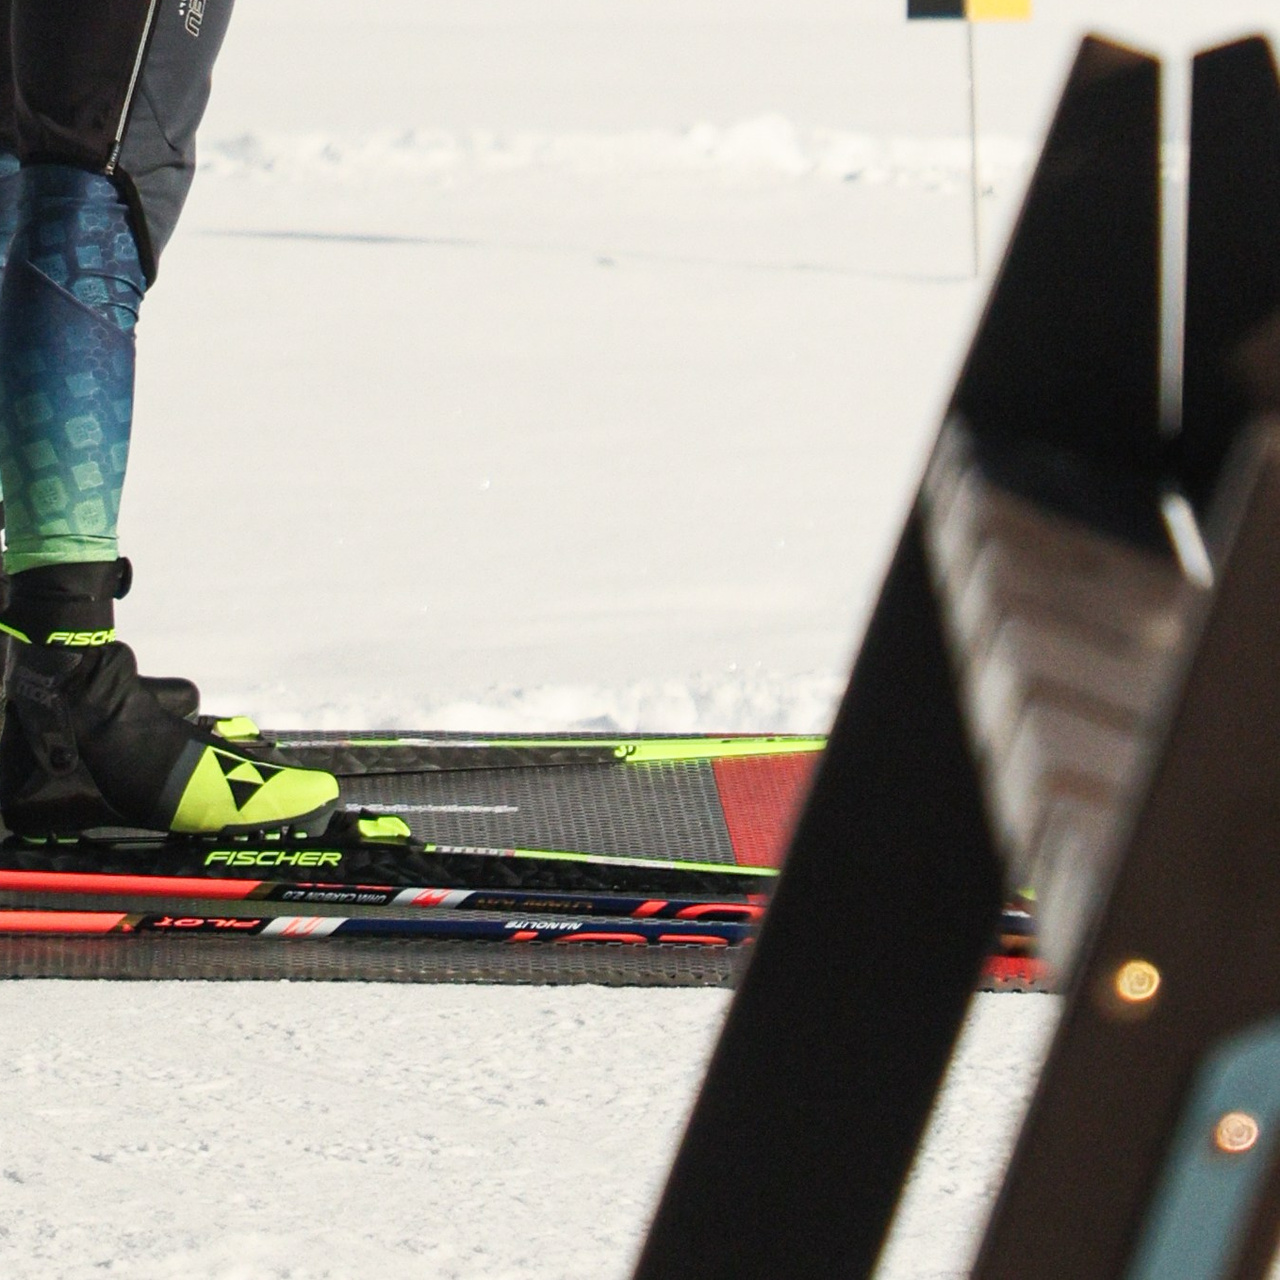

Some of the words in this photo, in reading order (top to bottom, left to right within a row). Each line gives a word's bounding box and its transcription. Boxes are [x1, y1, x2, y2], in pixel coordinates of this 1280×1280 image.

[204, 850, 343, 867] FISCHER
[306, 891, 356, 904] CARBON
[152, 916, 261, 928] PILOT
[504, 920, 584, 931] NANOLITE
